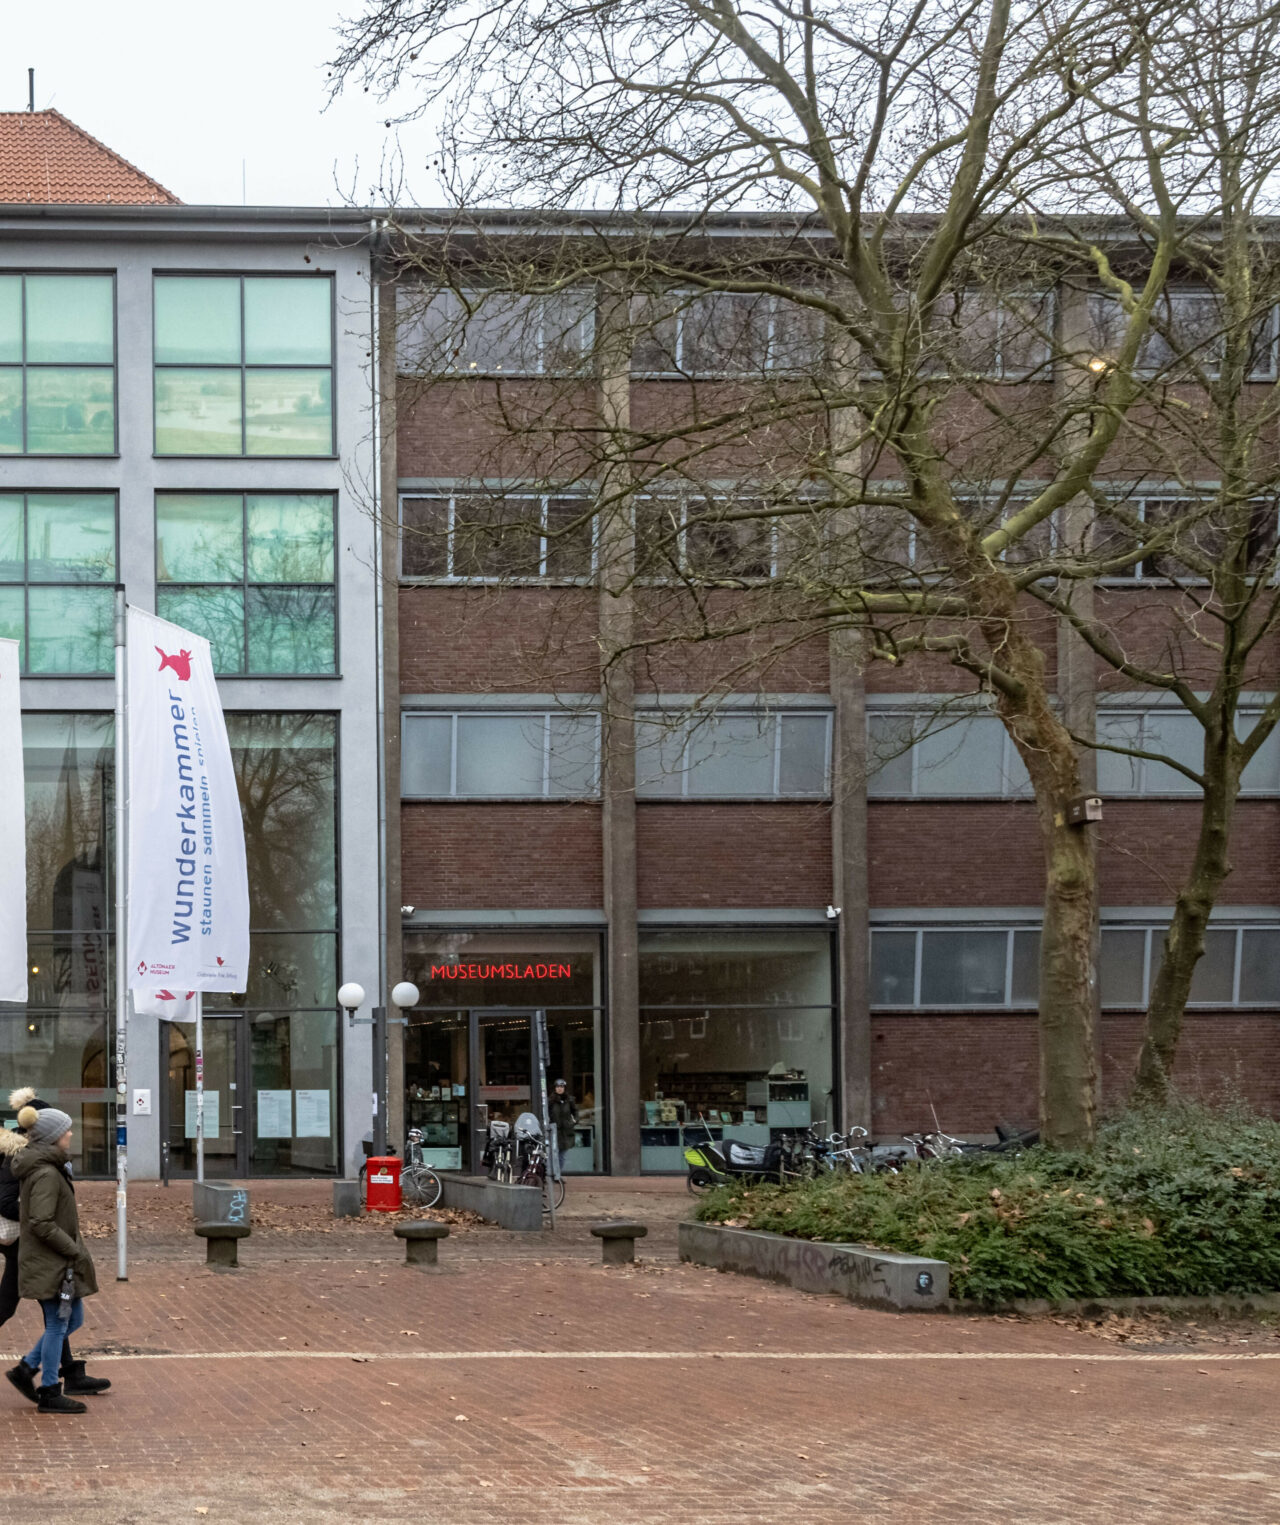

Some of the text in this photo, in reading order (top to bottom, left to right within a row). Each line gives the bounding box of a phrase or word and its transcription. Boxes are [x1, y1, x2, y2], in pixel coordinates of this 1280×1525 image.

[169, 688, 196, 945] wunderkammer
[199, 775, 213, 855] sammeln
[200, 864, 212, 936] staunen
[431, 963, 571, 980] MUSEUMSLADEN
